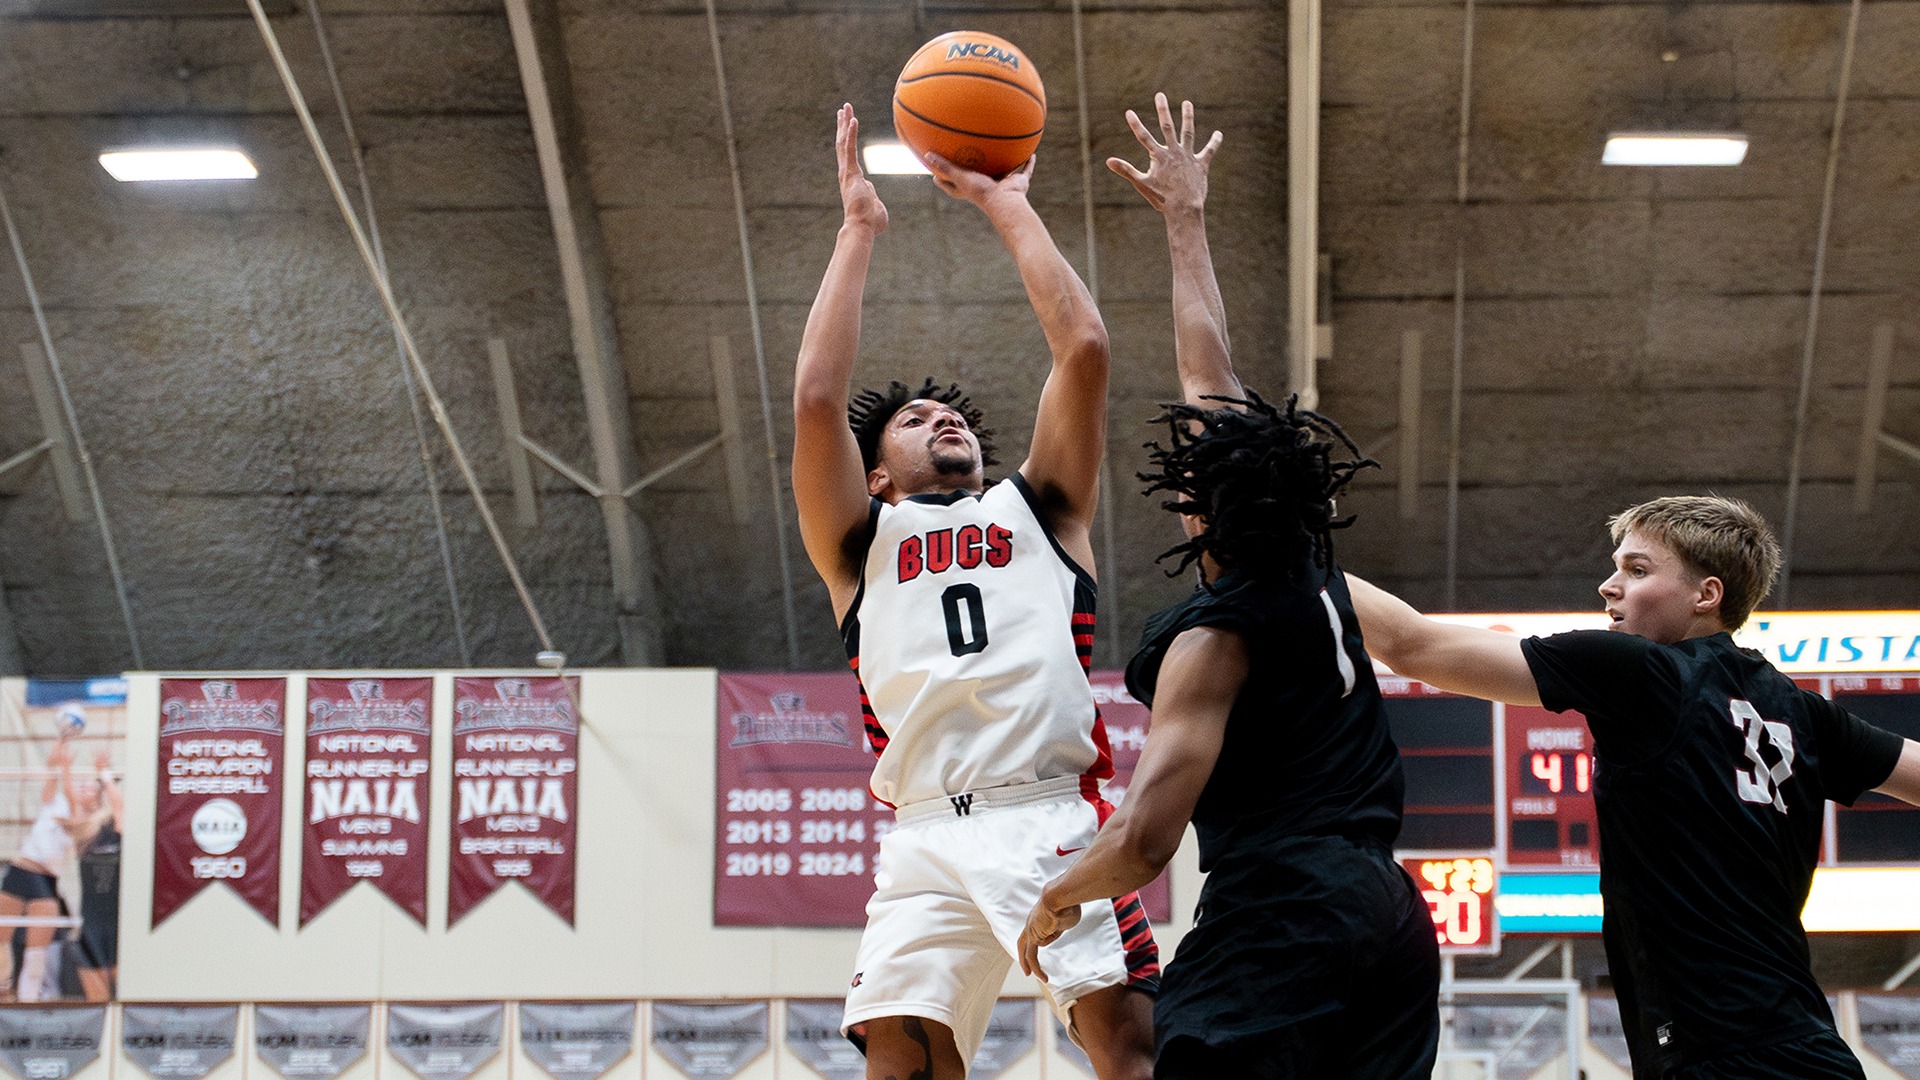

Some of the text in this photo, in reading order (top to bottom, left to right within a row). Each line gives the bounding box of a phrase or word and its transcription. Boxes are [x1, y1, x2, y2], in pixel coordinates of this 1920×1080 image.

[946, 42, 1019, 70] NCAA
[898, 522, 1013, 585] BUCS
[941, 582, 989, 658] 0
[1319, 587, 1356, 699] 1
[1758, 621, 1920, 663] VISTA
[173, 739, 268, 756] NATIONAL
[319, 735, 418, 753] NATIONAL
[466, 734, 566, 752] NATIONAL
[1526, 727, 1585, 751] HOME
[168, 758, 272, 775] CHAMPION
[307, 759, 429, 777] RUNNER-UP
[455, 758, 576, 777] RUNNER-UP
[1531, 752, 1590, 793] 41
[169, 776, 269, 794] BASEBALL
[310, 780, 420, 824] NAIA
[458, 780, 568, 824] NAIA
[727, 788, 866, 812] 2005 2008
[950, 793, 974, 817] W
[726, 820, 792, 844] 2013
[800, 820, 866, 844] 2014
[460, 837, 565, 855] BASKETBALL
[726, 852, 792, 876] 2019
[799, 852, 866, 876] 2024
